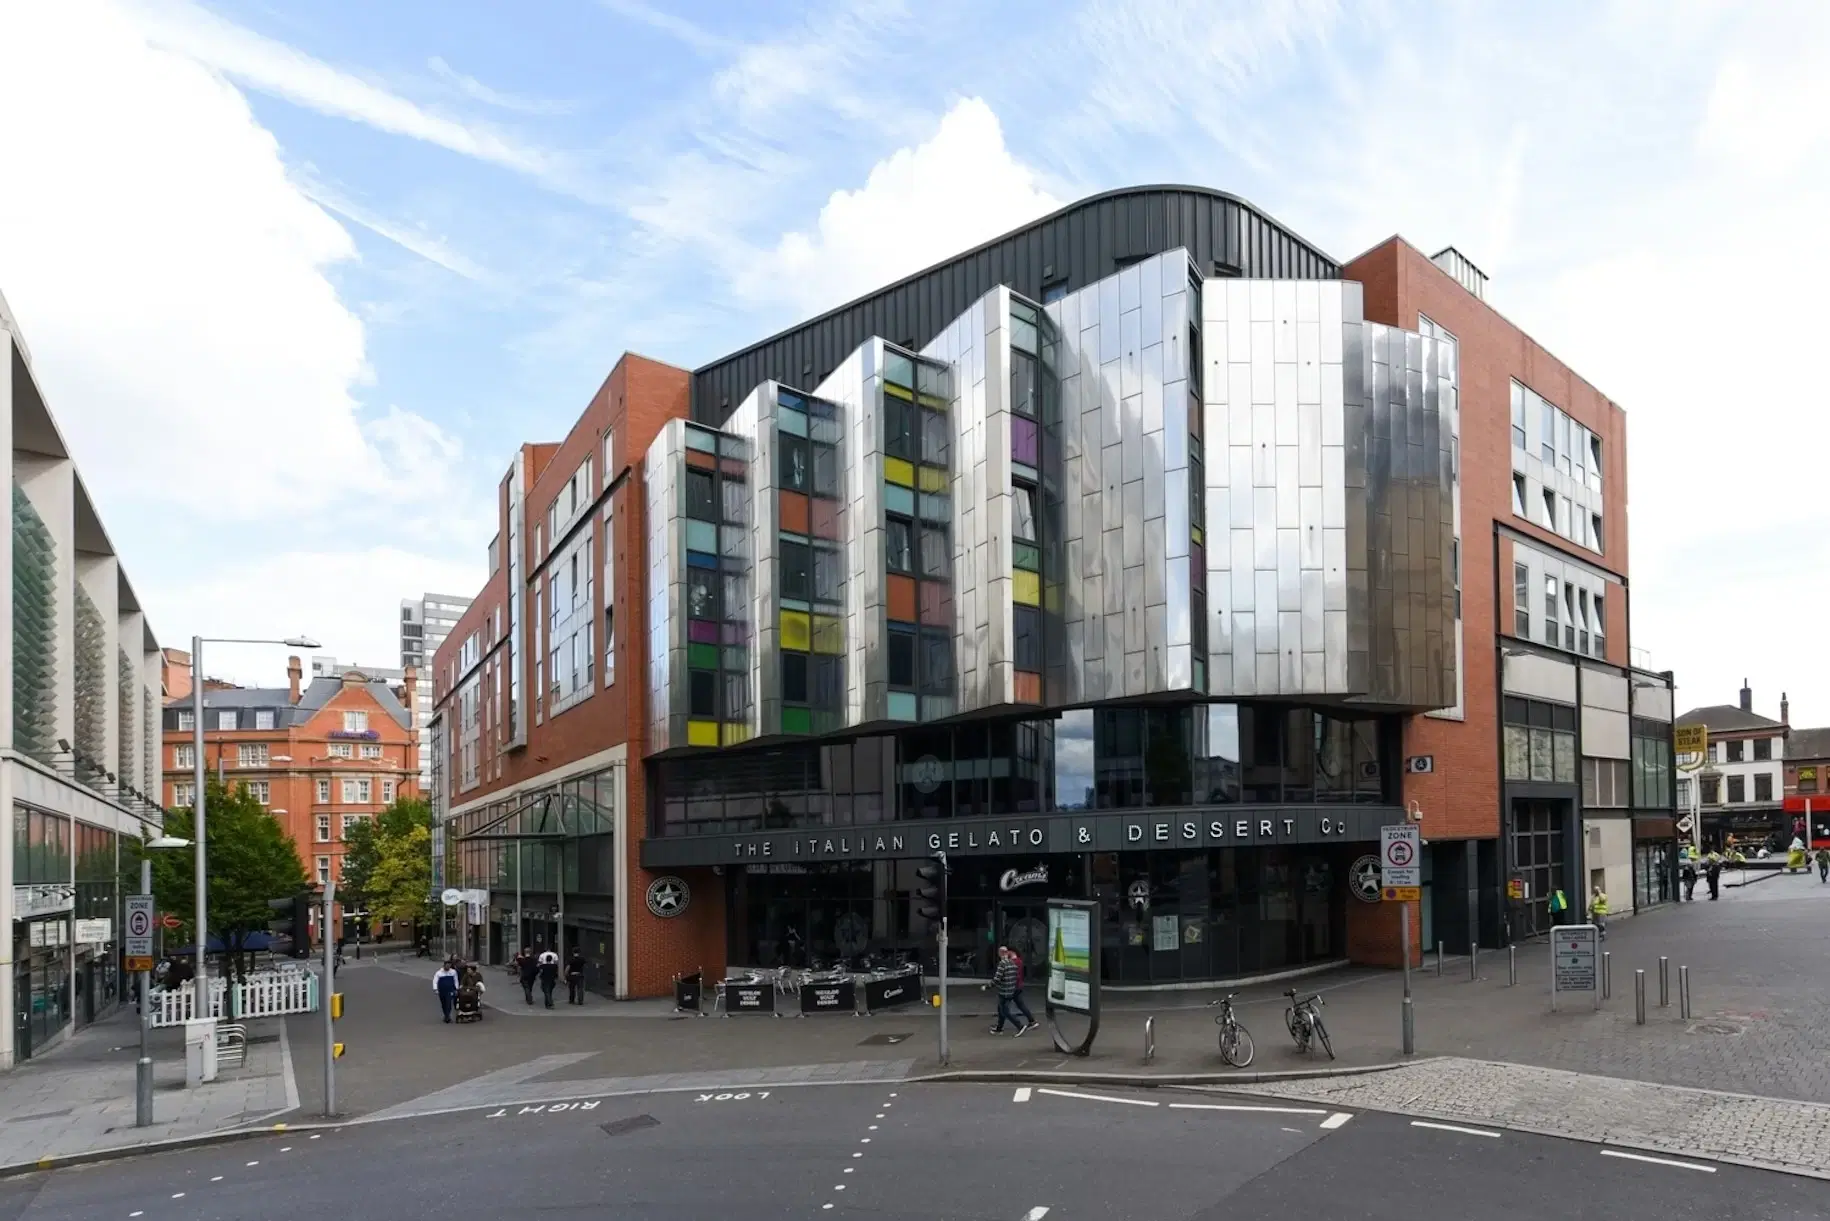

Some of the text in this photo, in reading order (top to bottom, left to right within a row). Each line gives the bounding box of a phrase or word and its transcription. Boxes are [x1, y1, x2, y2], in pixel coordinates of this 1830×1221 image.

[1678, 736, 1702, 745] STEAK
[733, 817, 1346, 856] THE ITALIAN GELATO & DESSERT Co
[1387, 831, 1413, 840] ZONE
[130, 902, 149, 910] ZONE
[694, 1091, 770, 1103] LOOK
[485, 1100, 601, 1119] RIGHT
